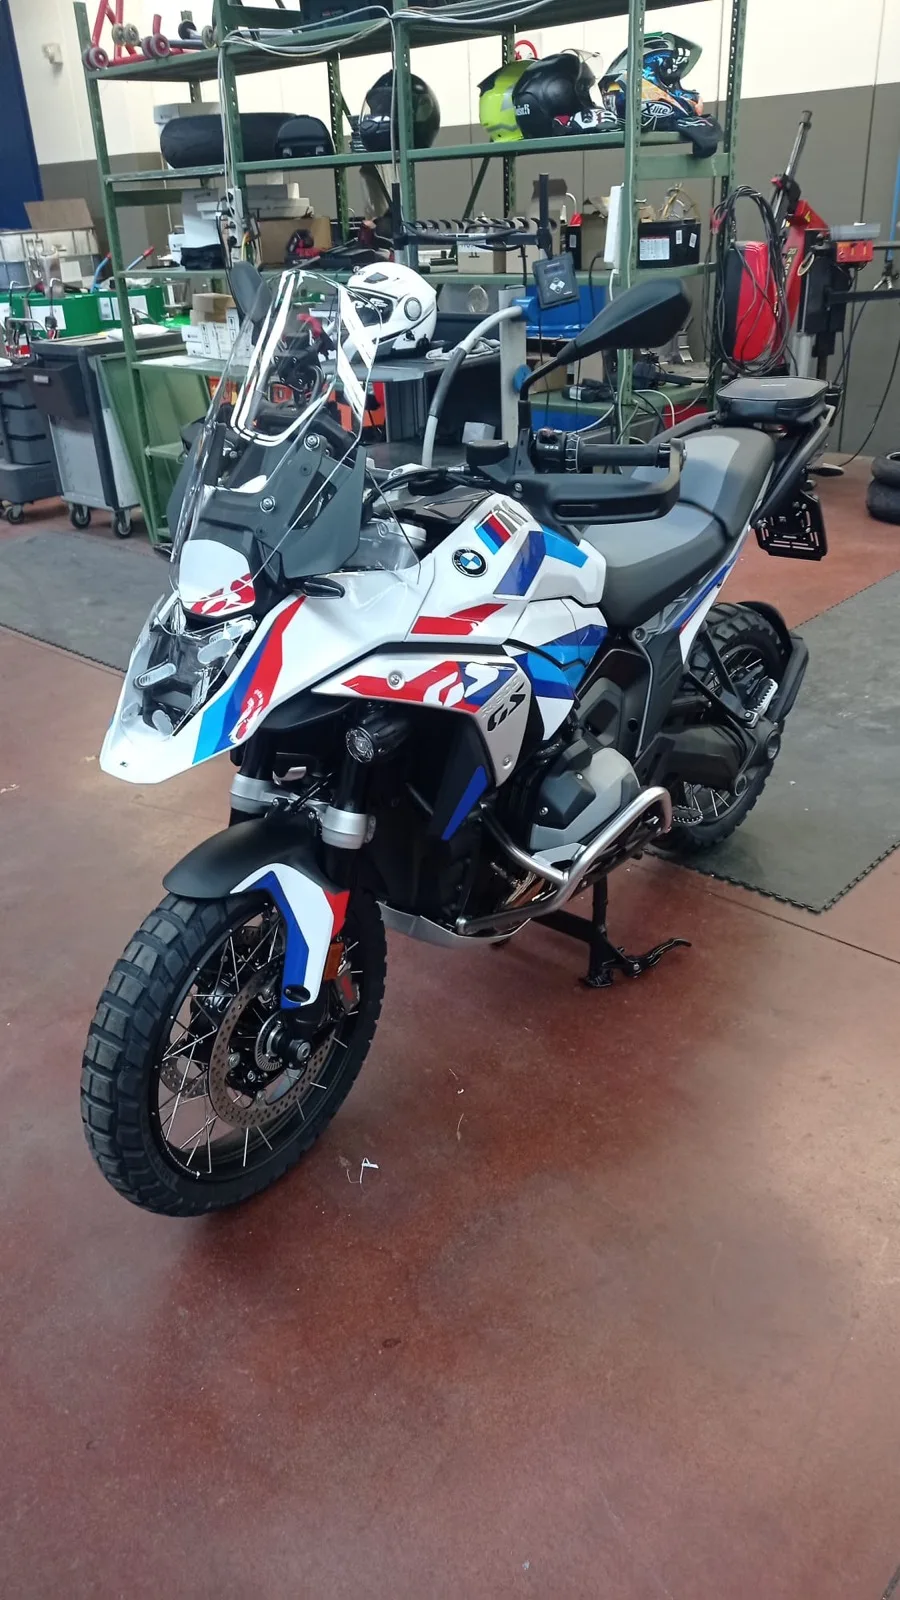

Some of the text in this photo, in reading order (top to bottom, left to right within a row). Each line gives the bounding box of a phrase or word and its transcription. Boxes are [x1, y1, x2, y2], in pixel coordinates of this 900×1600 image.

[642, 102, 669, 115] X-lite
[423, 661, 517, 707] GS
[487, 682, 526, 731] GS
